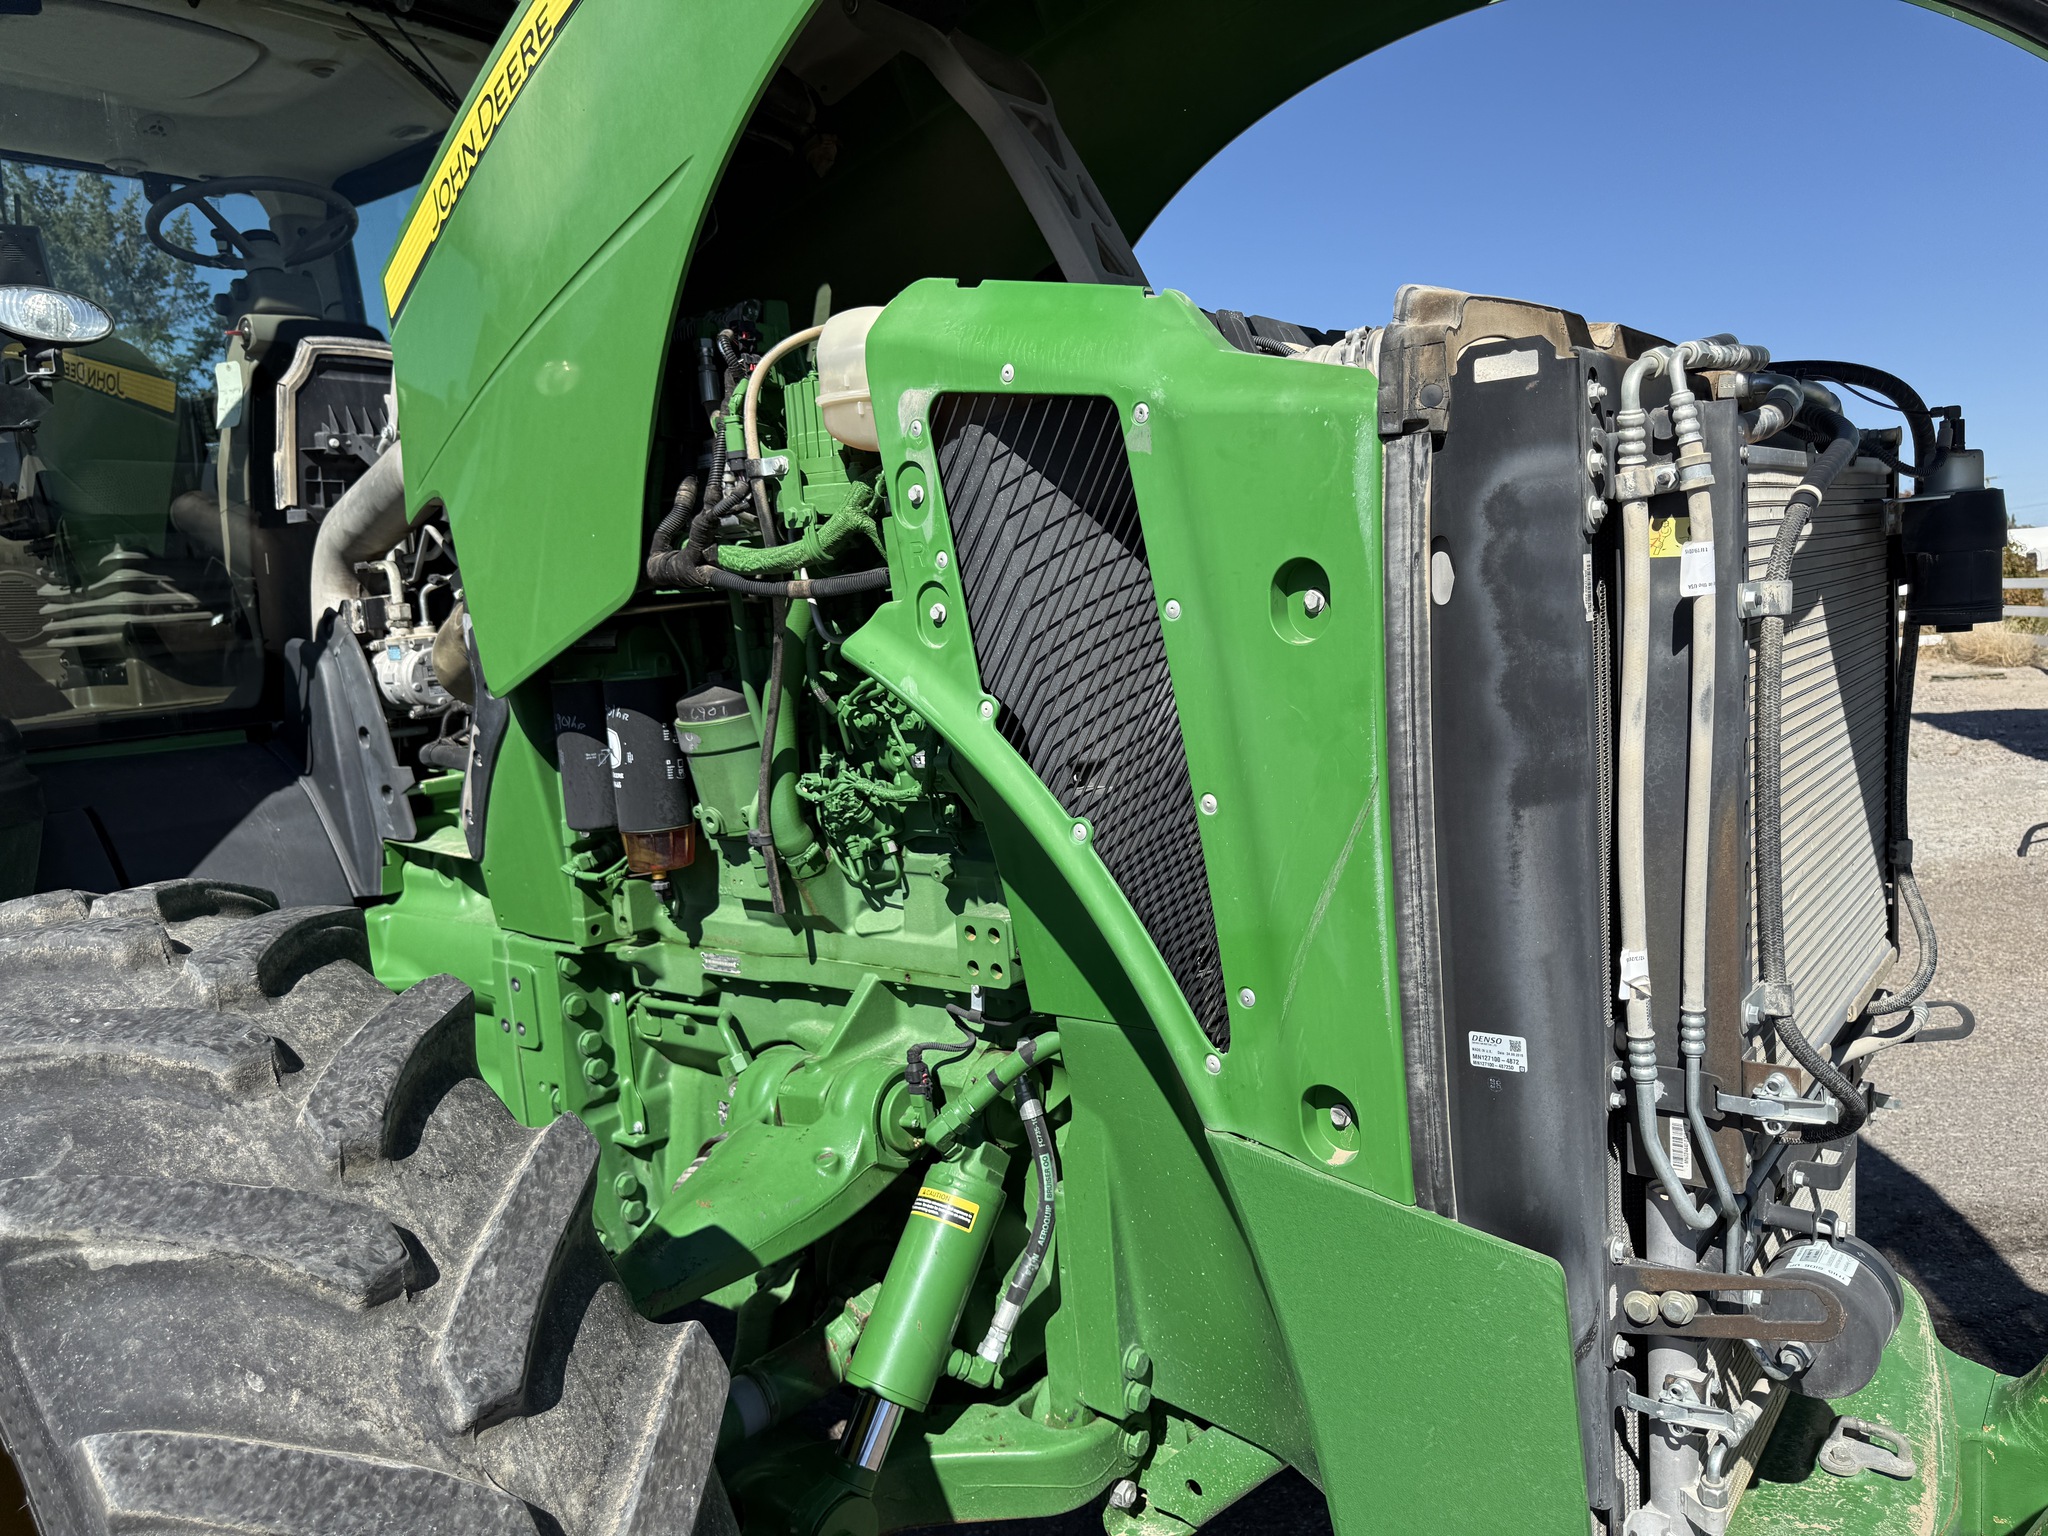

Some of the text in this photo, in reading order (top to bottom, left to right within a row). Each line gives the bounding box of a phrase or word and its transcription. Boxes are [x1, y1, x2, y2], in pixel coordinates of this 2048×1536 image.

[432, 3, 552, 231] JOHN DEERE
[1472, 1034, 1502, 1045] DENSO
[926, 1189, 951, 1202] CAUTION
[1044, 1167, 1054, 1199] BRUISER
[1037, 1204, 1052, 1247] AEROQUIP
